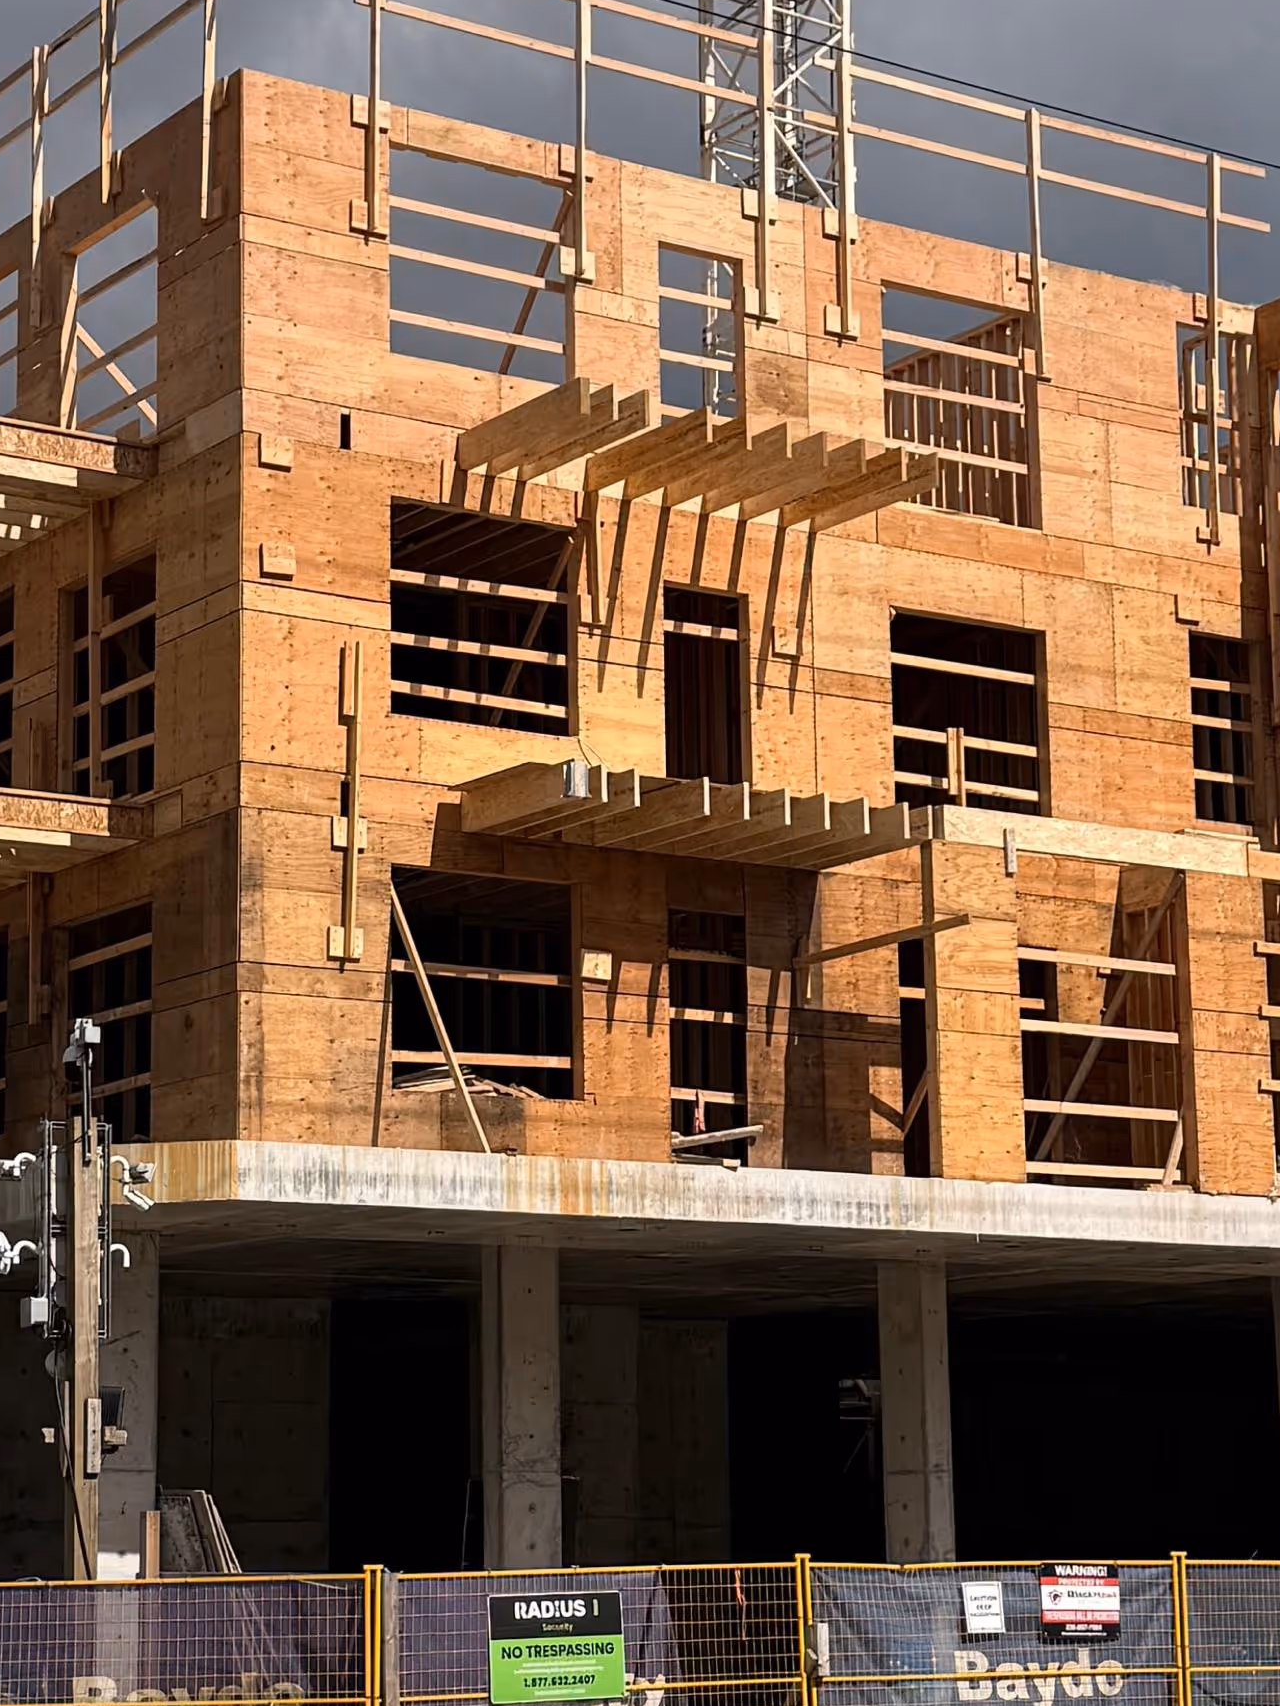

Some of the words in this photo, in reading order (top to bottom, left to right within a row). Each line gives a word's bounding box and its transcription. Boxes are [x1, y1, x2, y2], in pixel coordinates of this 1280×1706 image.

[514, 1599, 587, 1620] RADIUS
[501, 1645, 523, 1660] NO
[525, 1642, 615, 1659] TRESPASSING
